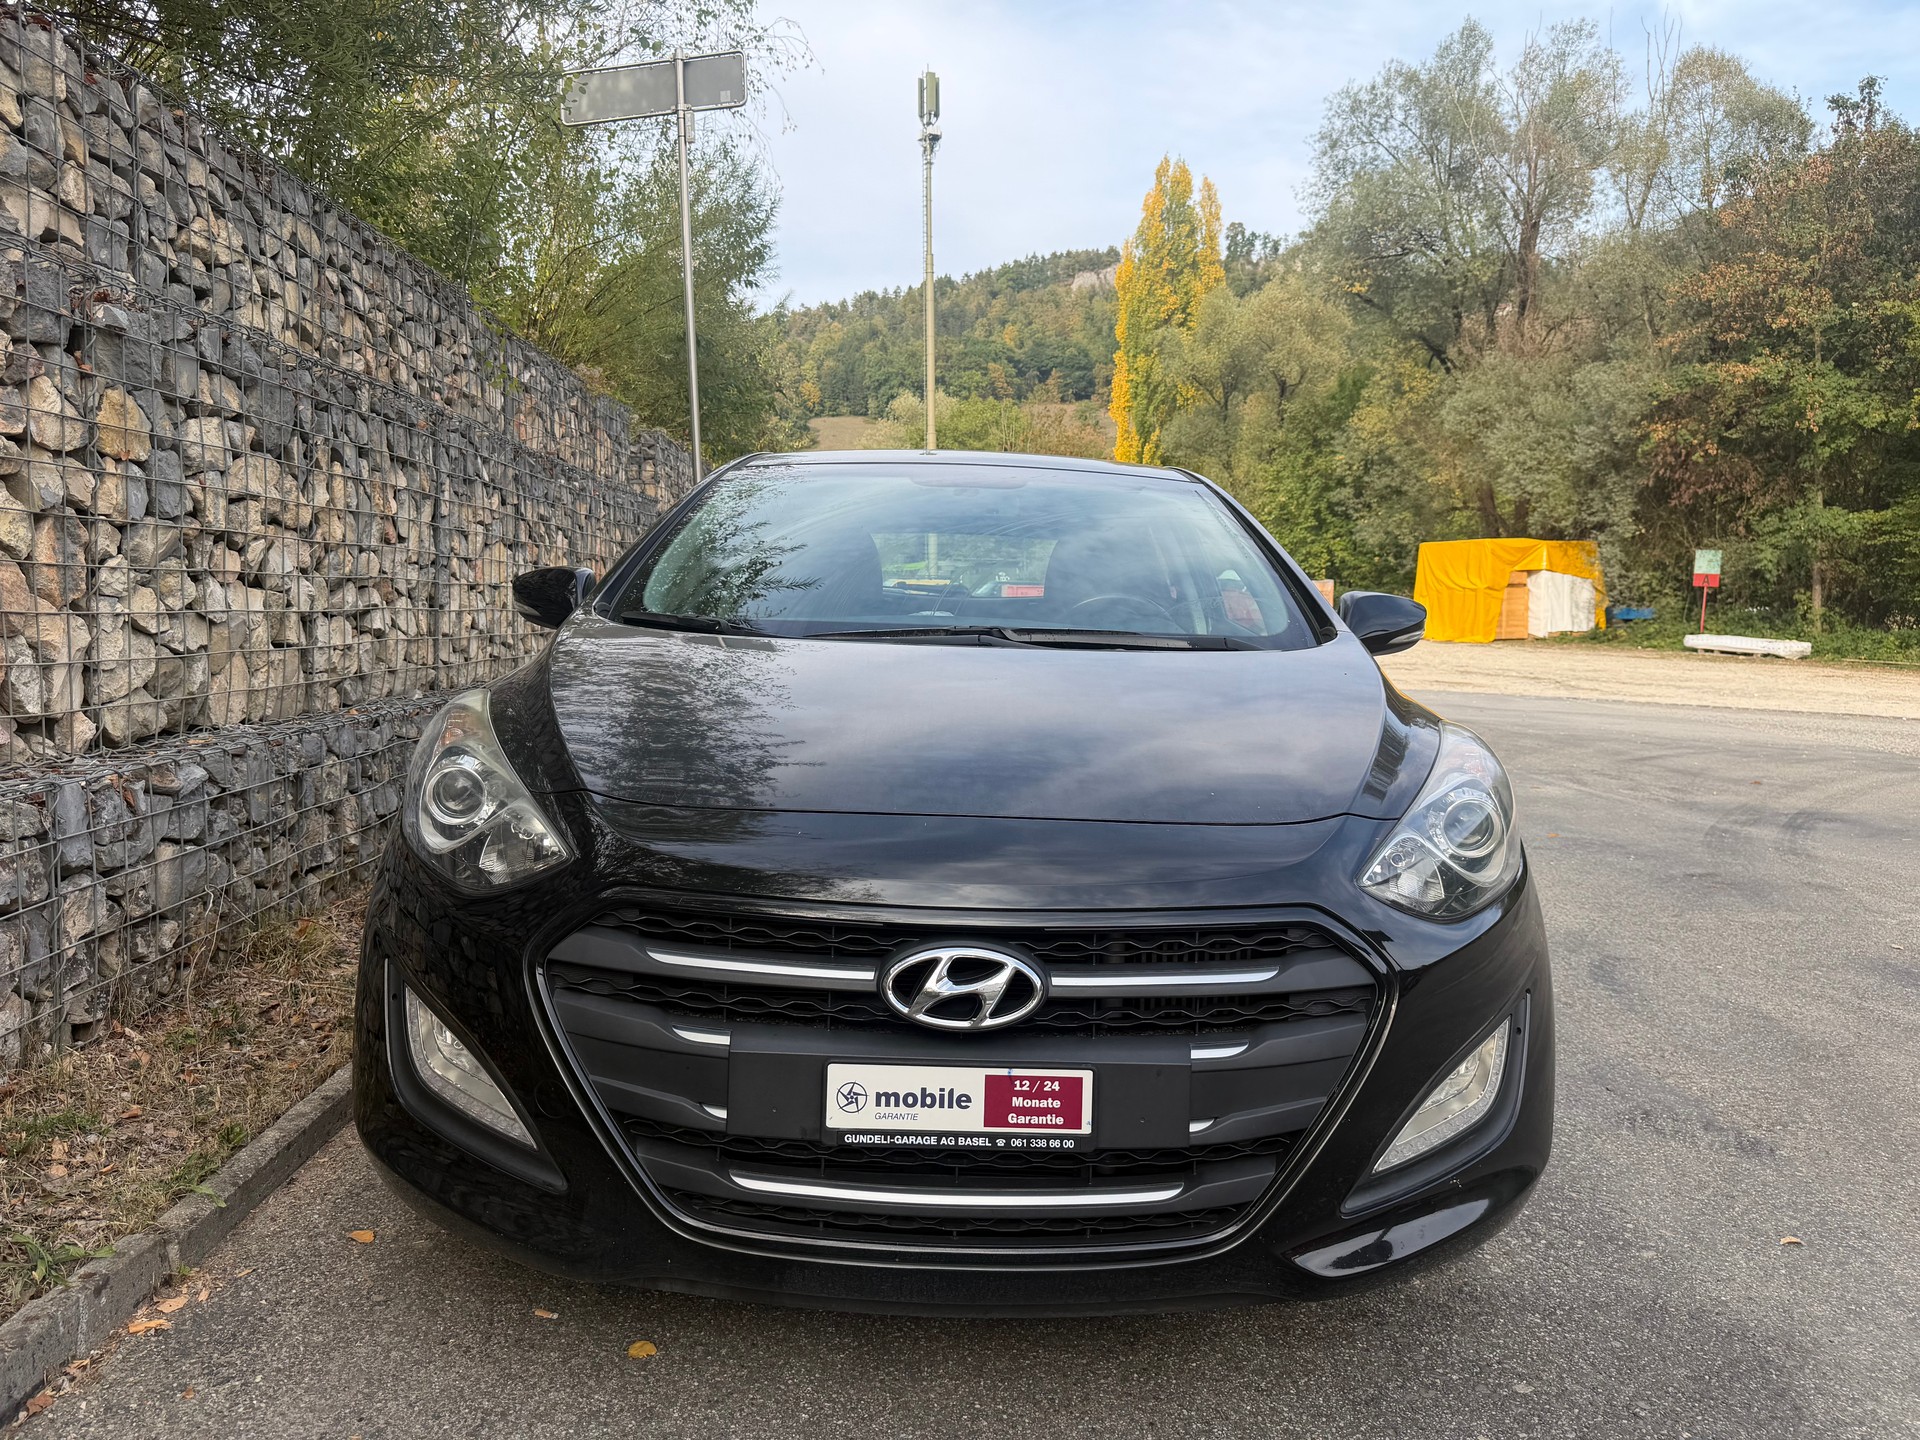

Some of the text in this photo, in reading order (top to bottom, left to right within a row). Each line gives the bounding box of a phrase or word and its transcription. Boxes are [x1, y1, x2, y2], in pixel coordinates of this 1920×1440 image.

[1014, 1080, 1060, 1092] 12 / 24
[875, 1087, 972, 1109] mobile
[1012, 1097, 1061, 1108] Monate
[874, 1113, 919, 1121] GARANTIE
[1008, 1113, 1064, 1125] Garantie
[844, 1134, 1074, 1148] GUNDELI-GARAGE AG BASEL 061 338 66 00
